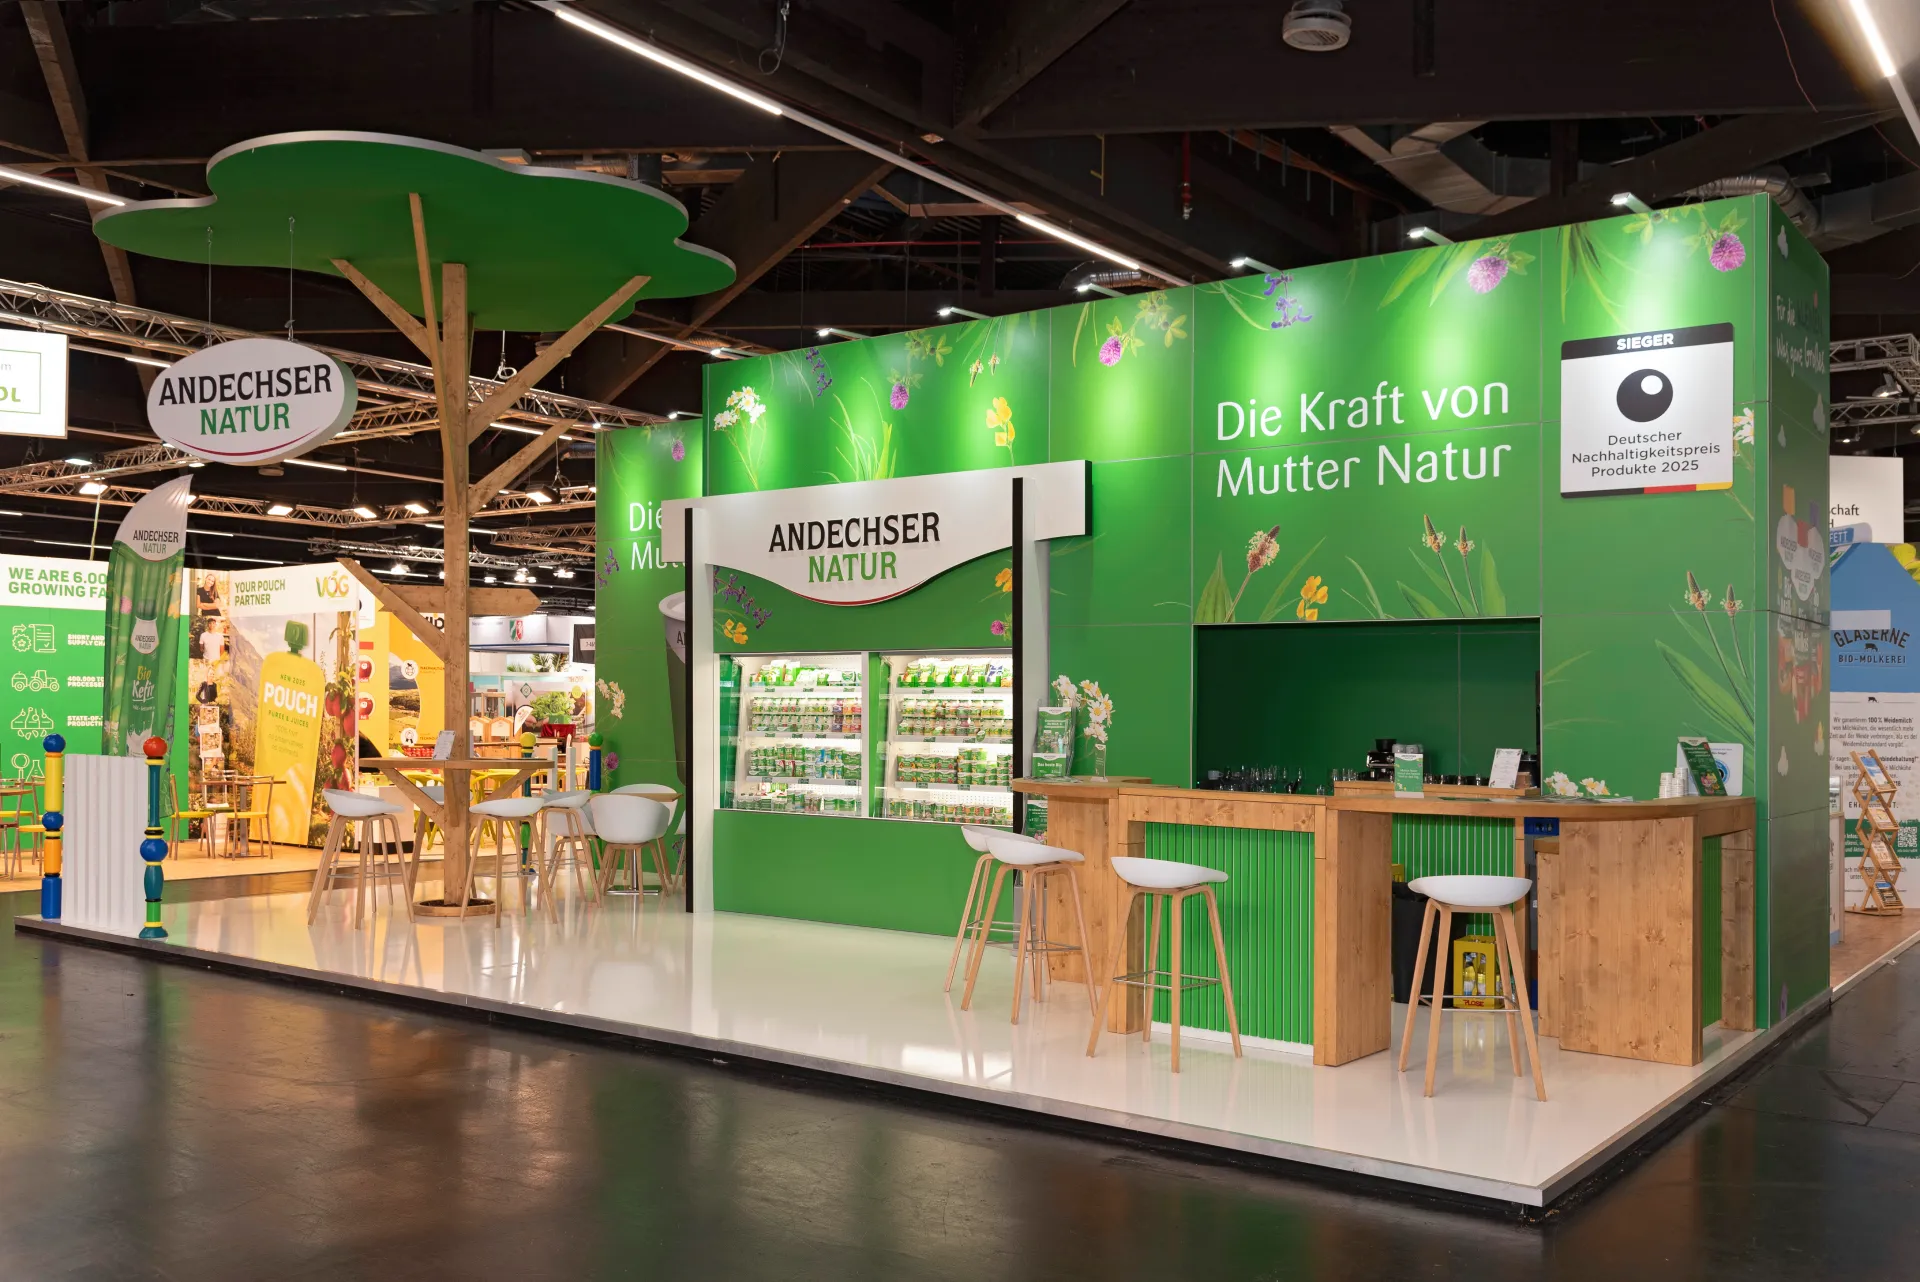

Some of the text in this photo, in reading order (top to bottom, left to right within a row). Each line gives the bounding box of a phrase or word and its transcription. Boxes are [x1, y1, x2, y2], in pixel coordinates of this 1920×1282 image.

[1616, 333, 1674, 350] SIEGER
[158, 364, 332, 406] ANDECHSER
[200, 402, 290, 435] NATUR
[1217, 380, 1508, 441] Die Kraft von
[1608, 431, 1682, 446] Deutscher
[1572, 443, 1720, 464] Nachhaltigkeitspreis
[1216, 442, 1512, 498] Mutter Natur
[1592, 460, 1699, 477] Produkte 2025
[1830, 504, 1859, 516] chaft
[133, 530, 179, 543] ANDECHSER
[768, 512, 940, 552] ANDECHSER
[142, 542, 167, 554] NATUR
[8, 567, 34, 580] WE
[38, 570, 69, 582] ARE
[808, 551, 897, 583] NATUR
[8, 582, 85, 597] GROWING
[235, 579, 286, 594] YOUR POUCH
[234, 594, 271, 606] PARTNER
[1838, 655, 1906, 664] BIO-MOLKEREI
[280, 674, 291, 682] NEW
[132, 680, 154, 702] Kefir
[264, 681, 318, 718] POUCH
